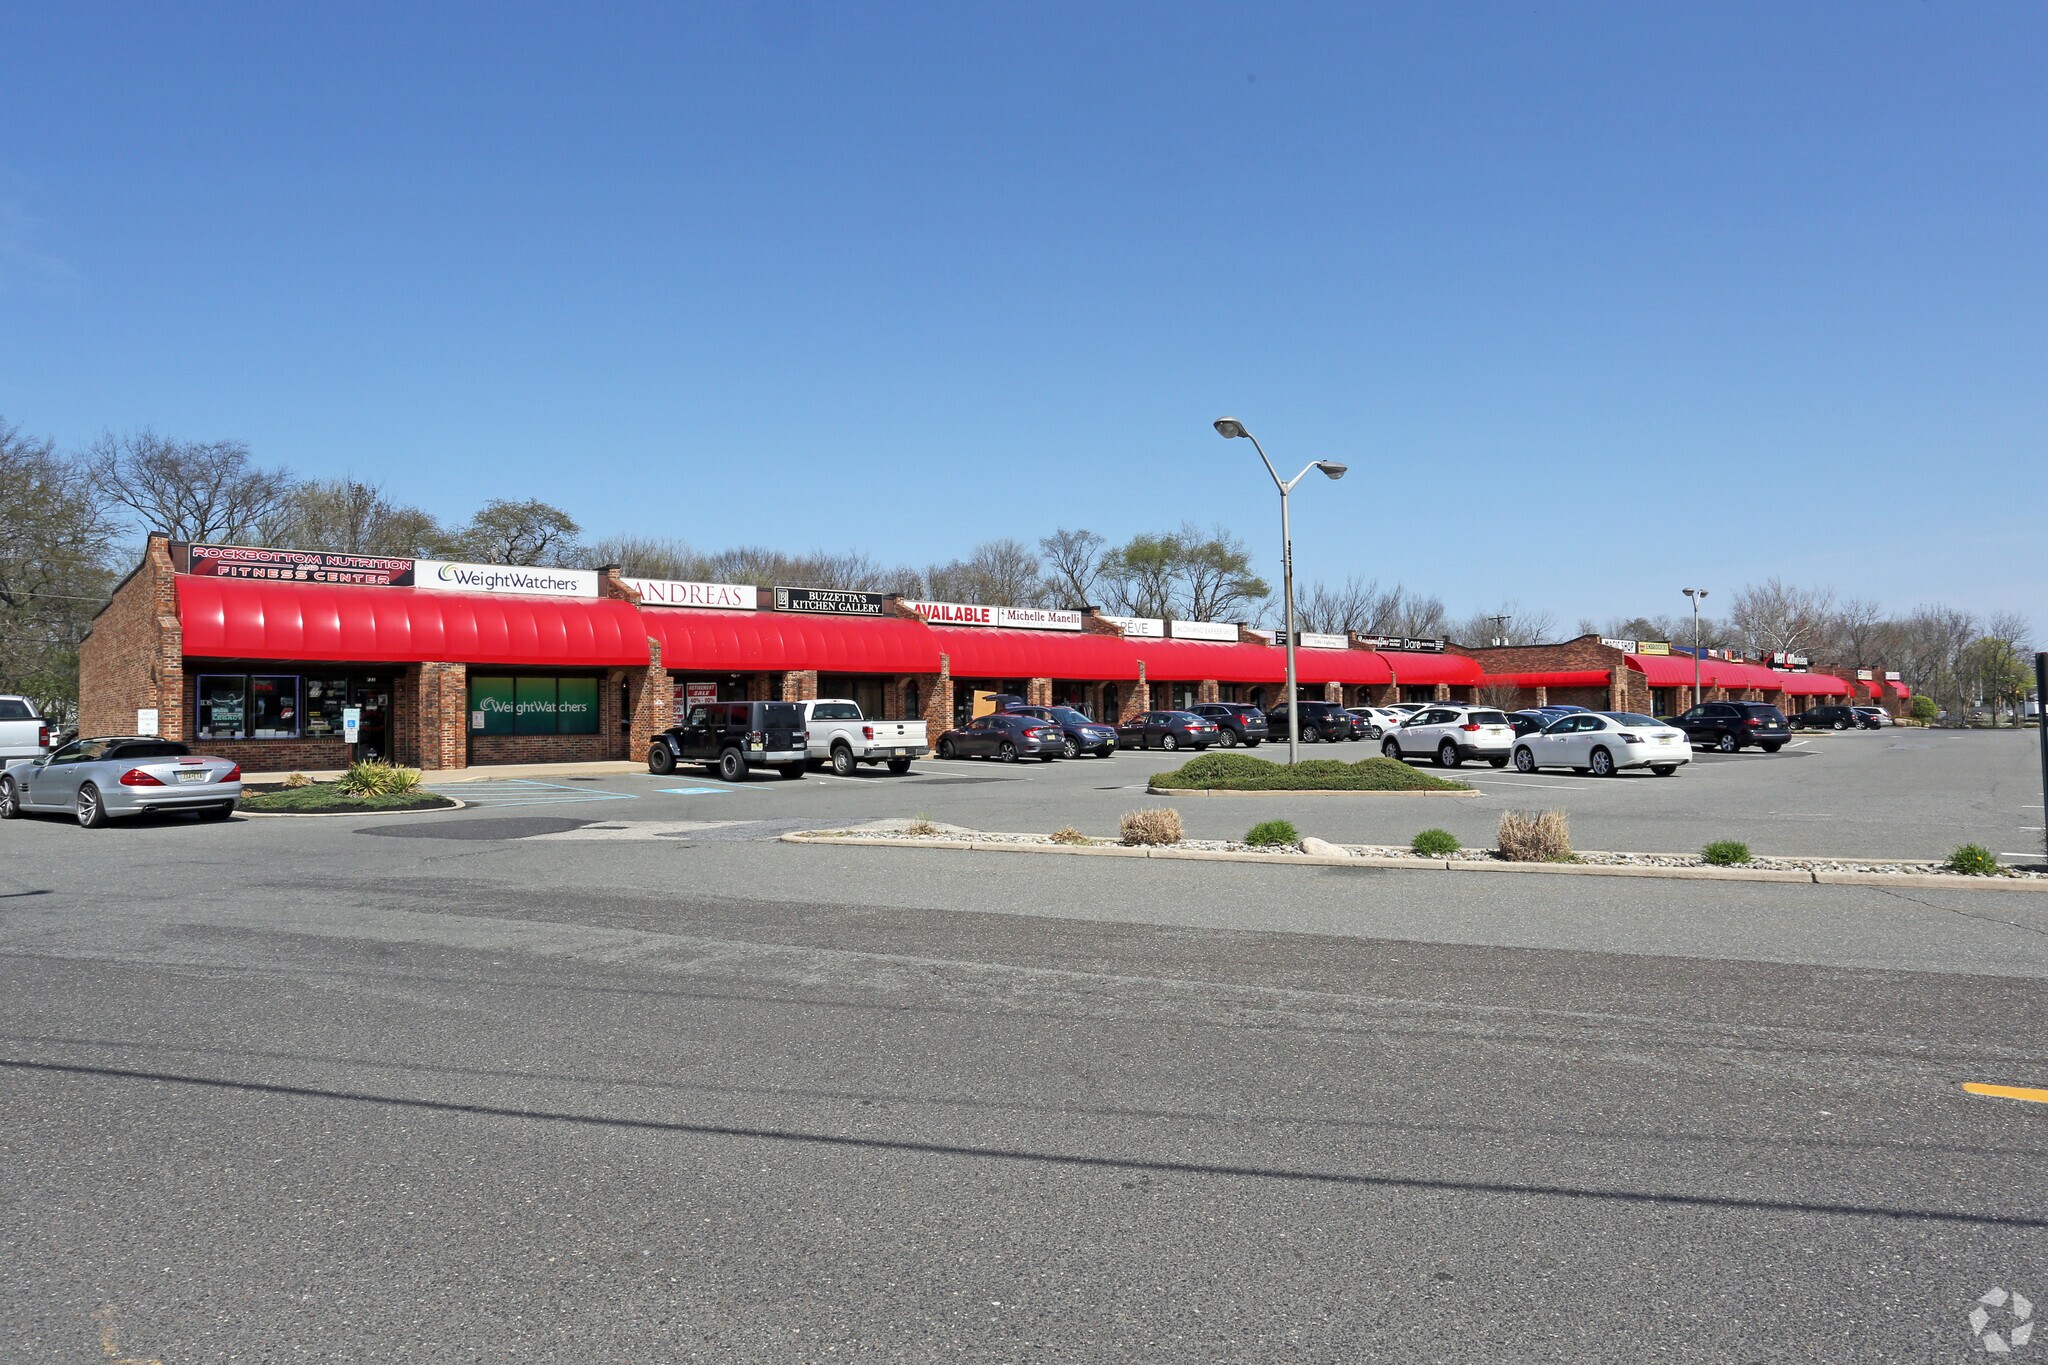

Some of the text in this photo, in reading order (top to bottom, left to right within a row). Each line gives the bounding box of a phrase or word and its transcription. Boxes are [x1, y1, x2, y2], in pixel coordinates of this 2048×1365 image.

[193, 547, 412, 570] ROCKBOTTOM NUTRITION
[218, 566, 389, 584] FITNESS CENTER
[454, 570, 578, 590] WeightWatchers
[634, 582, 742, 606] ANDREA'S
[808, 591, 867, 603] BUZZETTA'S
[793, 600, 880, 613] KITCHEN GALLERY
[1007, 609, 1080, 624] Michelle Manelli
[492, 701, 587, 715] WeightWatchers
